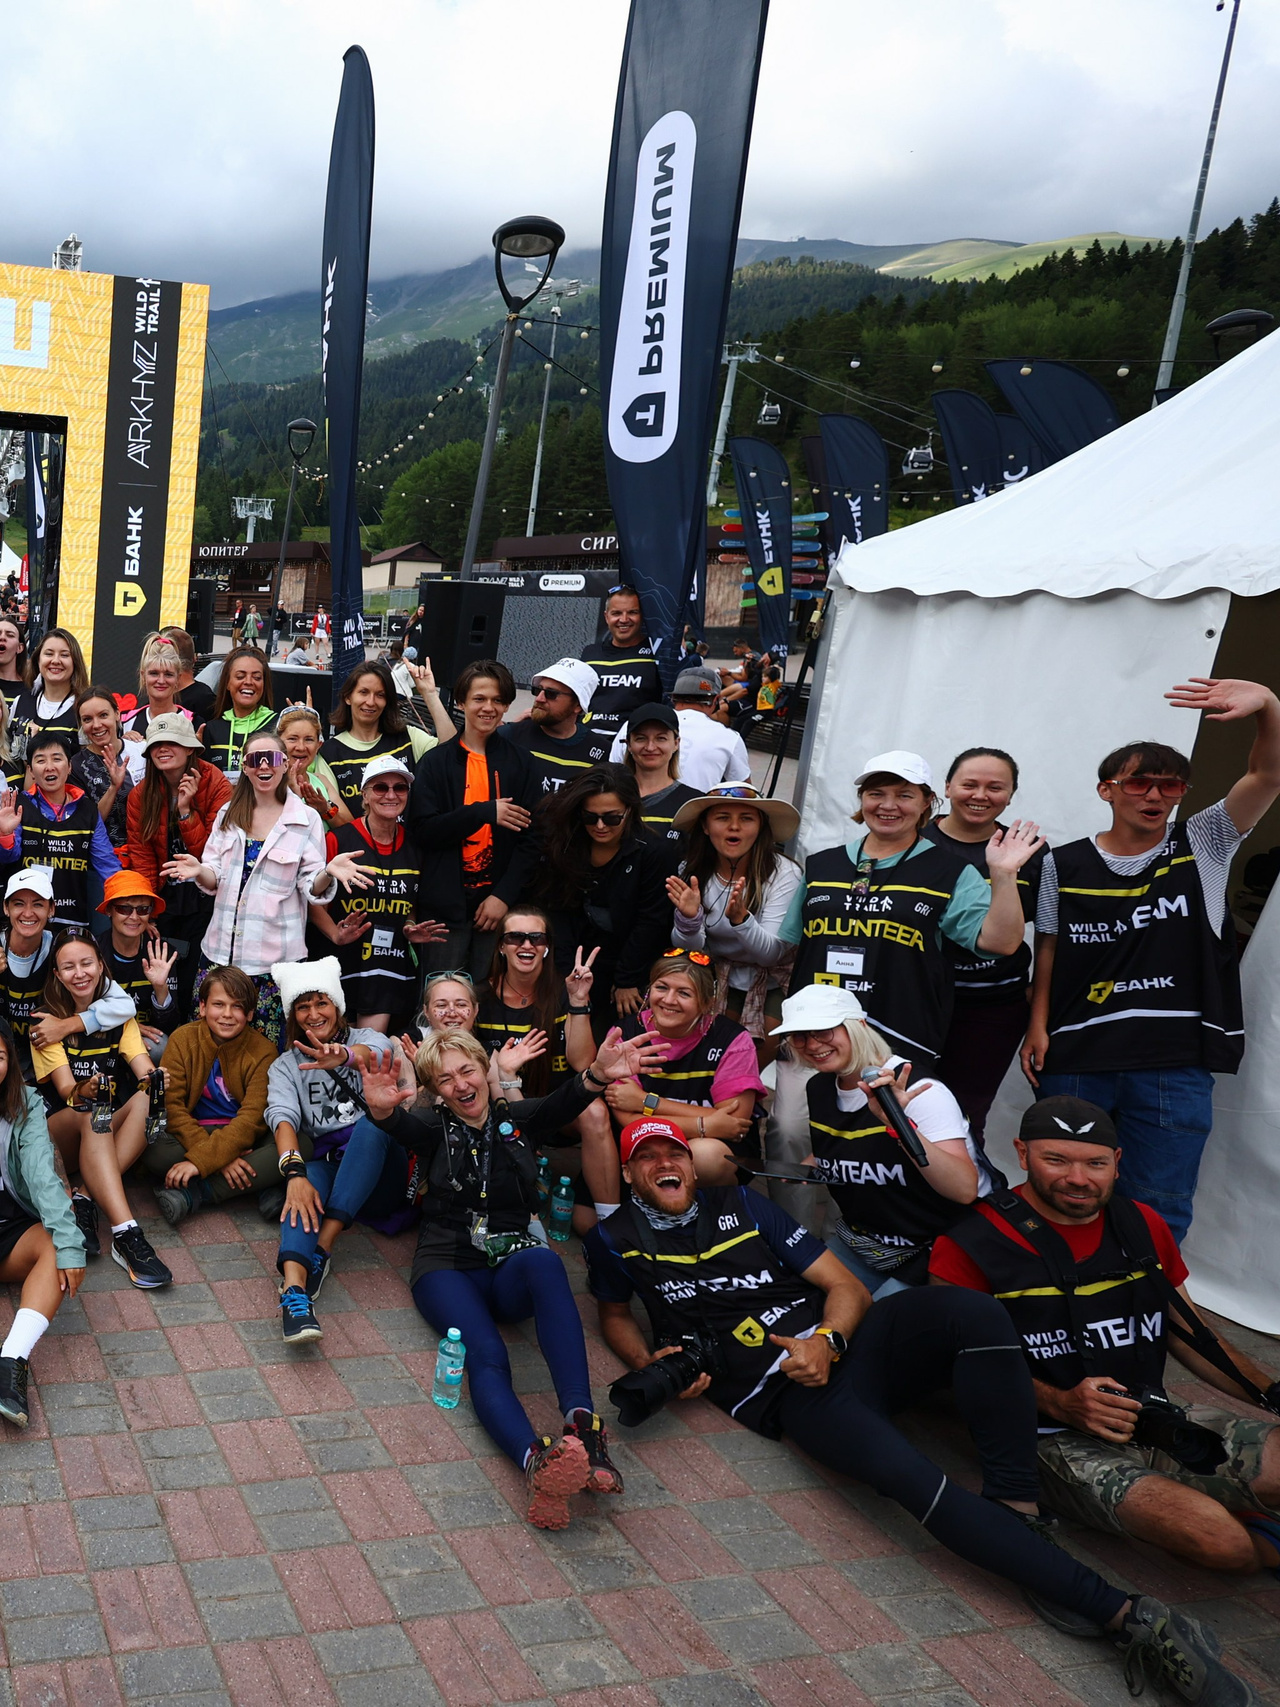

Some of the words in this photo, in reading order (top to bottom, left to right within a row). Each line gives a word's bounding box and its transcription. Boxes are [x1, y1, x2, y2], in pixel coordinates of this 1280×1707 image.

[135, 290, 148, 334] WILD
[147, 288, 161, 335] TRAIL
[127, 340, 158, 469] ARKHYZ
[123, 506, 145, 577] БАНК
[580, 536, 619, 552] СИР
[198, 545, 249, 557] ЮПИТЕР
[600, 675, 642, 689] TEAM
[590, 747, 605, 761] GRi
[666, 830, 680, 841] GRi
[914, 901, 934, 917] GRi
[803, 917, 926, 953] VOLUNTEER
[1068, 922, 1109, 934] WILD
[1069, 932, 1116, 944] TRAIL
[373, 947, 405, 959] БАНК
[835, 959, 855, 967] Анна
[1113, 975, 1176, 994] БАНК
[839, 1160, 908, 1187] TEAM
[718, 1213, 740, 1232] GRi
[1022, 1329, 1068, 1347] WILD
[1027, 1341, 1078, 1361] TRAIL
